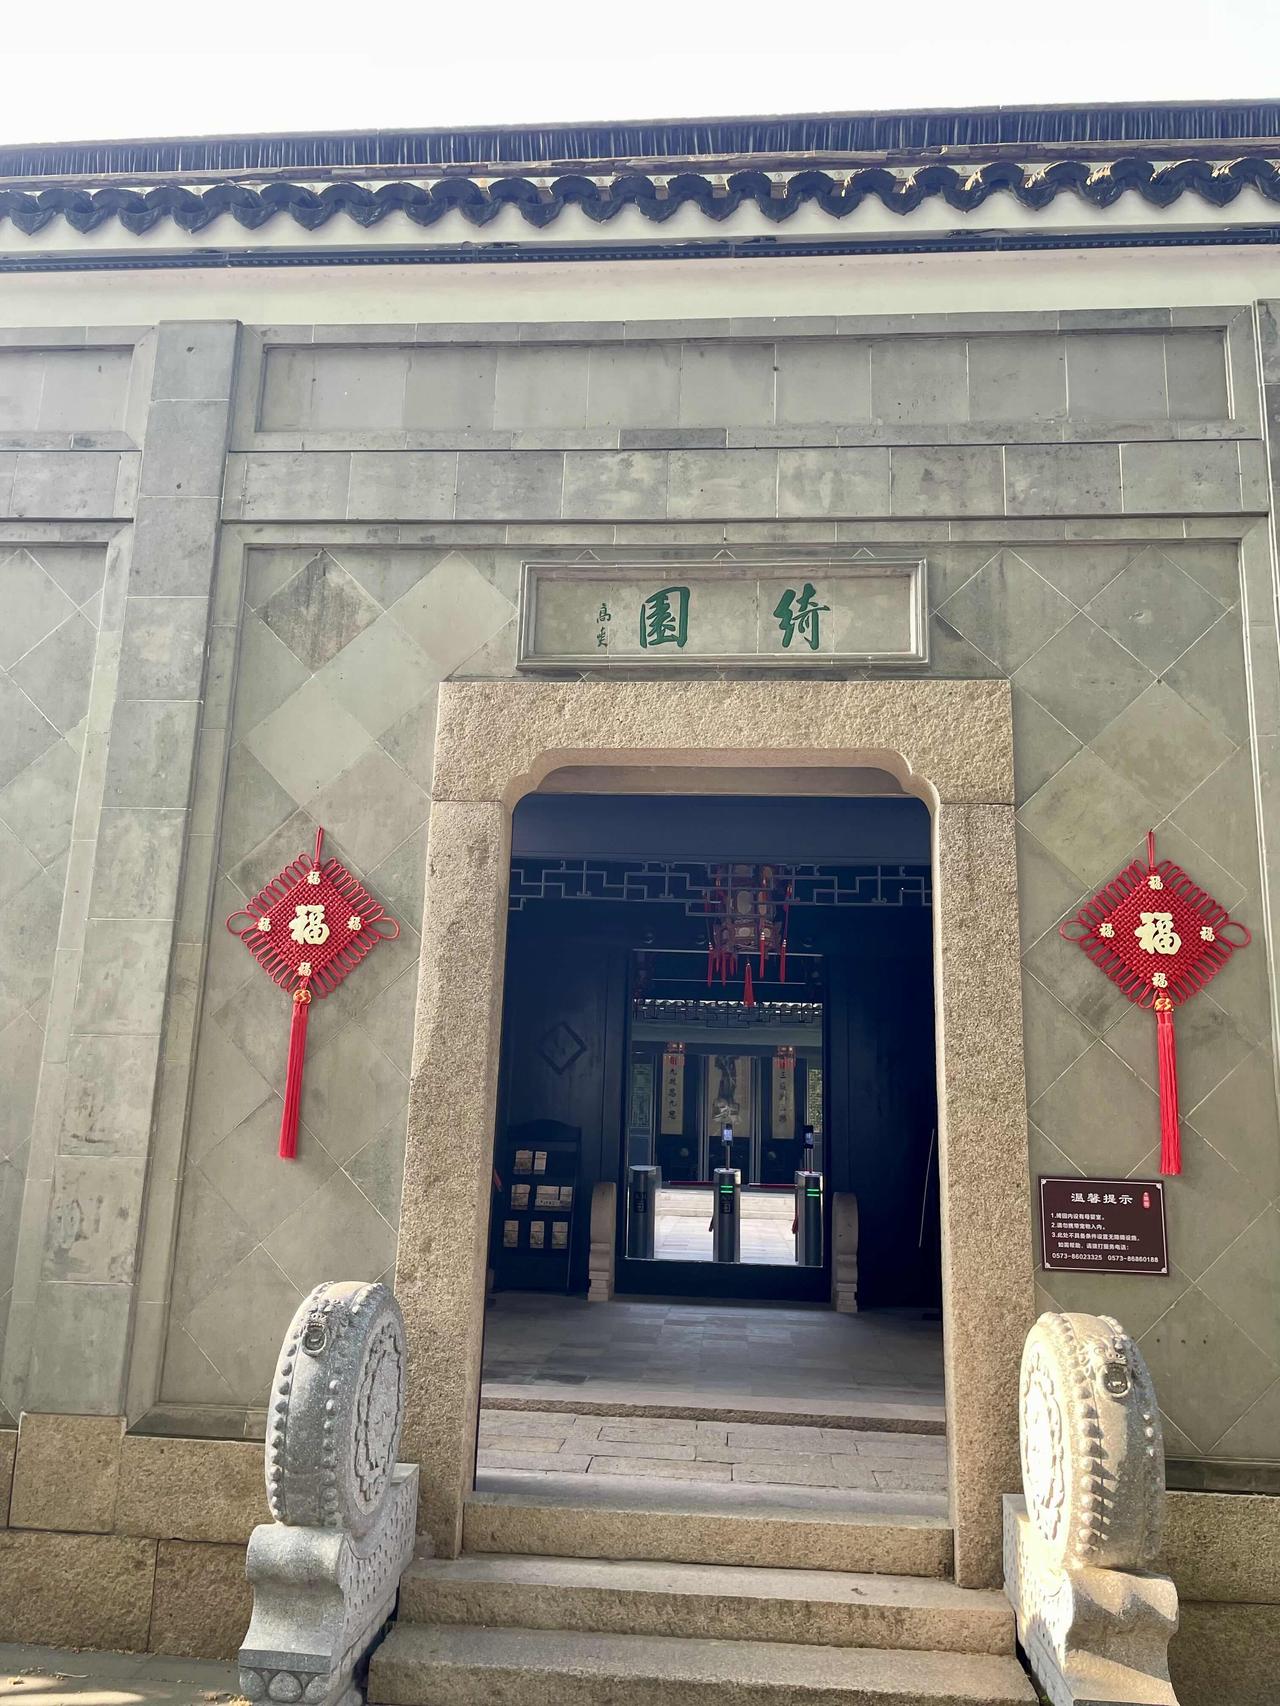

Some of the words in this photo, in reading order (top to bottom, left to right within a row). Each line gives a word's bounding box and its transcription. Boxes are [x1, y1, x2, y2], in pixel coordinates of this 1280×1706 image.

[288, 904, 331, 945] 福
[1134, 911, 1182, 956] 福
[1070, 1192, 1134, 1205] 温馨提示
